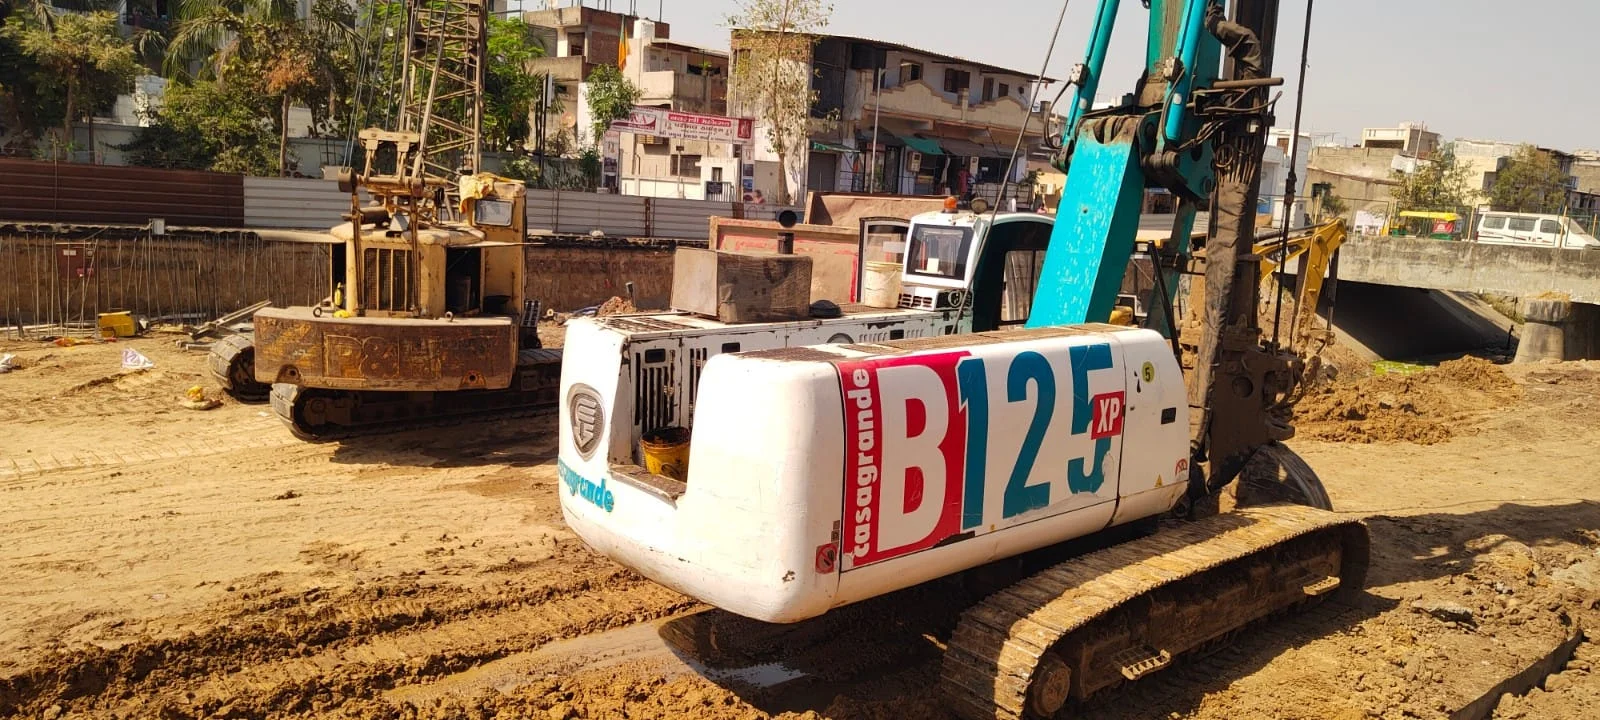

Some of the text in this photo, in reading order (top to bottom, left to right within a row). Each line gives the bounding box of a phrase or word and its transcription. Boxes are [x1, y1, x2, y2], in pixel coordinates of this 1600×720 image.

[848, 368, 878, 558] casagrande
[878, 344, 1121, 552] B125 XP
[1144, 366, 1153, 382] 5
